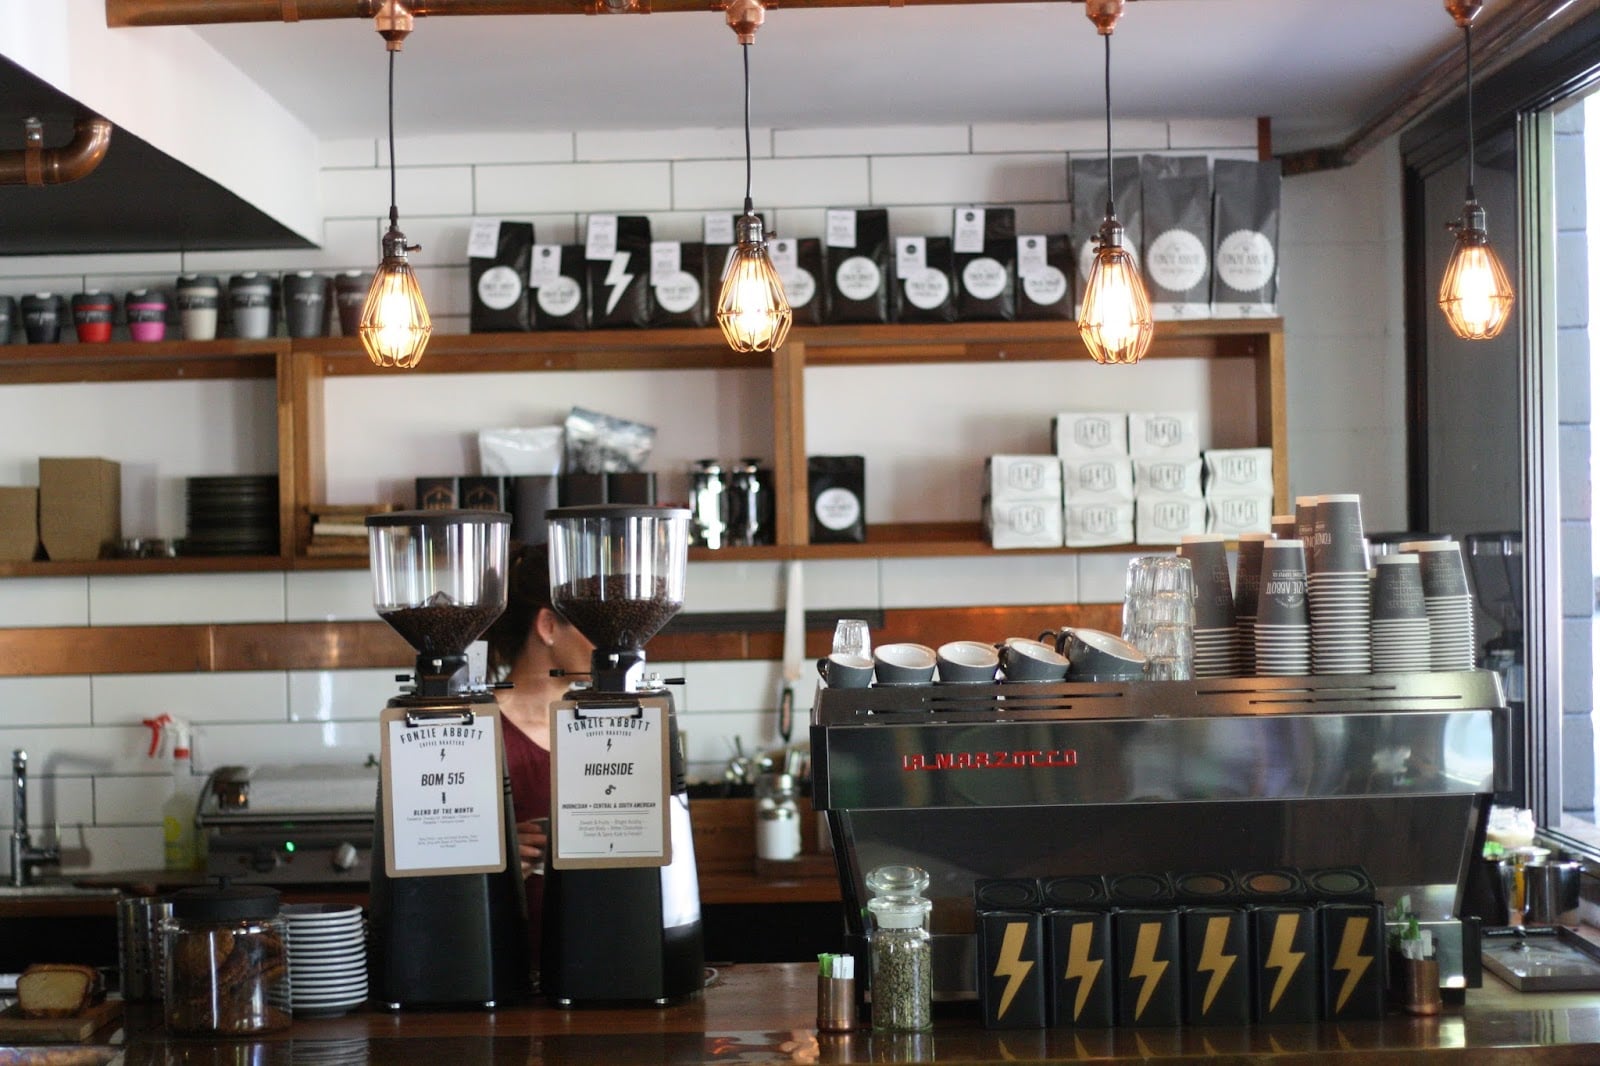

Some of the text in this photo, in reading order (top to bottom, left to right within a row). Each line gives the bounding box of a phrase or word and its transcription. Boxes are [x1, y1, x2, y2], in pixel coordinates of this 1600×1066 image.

[1266, 582, 1290, 594] ABBOTT
[568, 718, 650, 733] FONZIE ABBOTT
[400, 728, 483, 744] FONZIE ABBOTT
[936, 748, 1077, 769] MARZOCCO
[585, 763, 634, 776] HIGHSIDE
[421, 772, 465, 786] BOM 515
